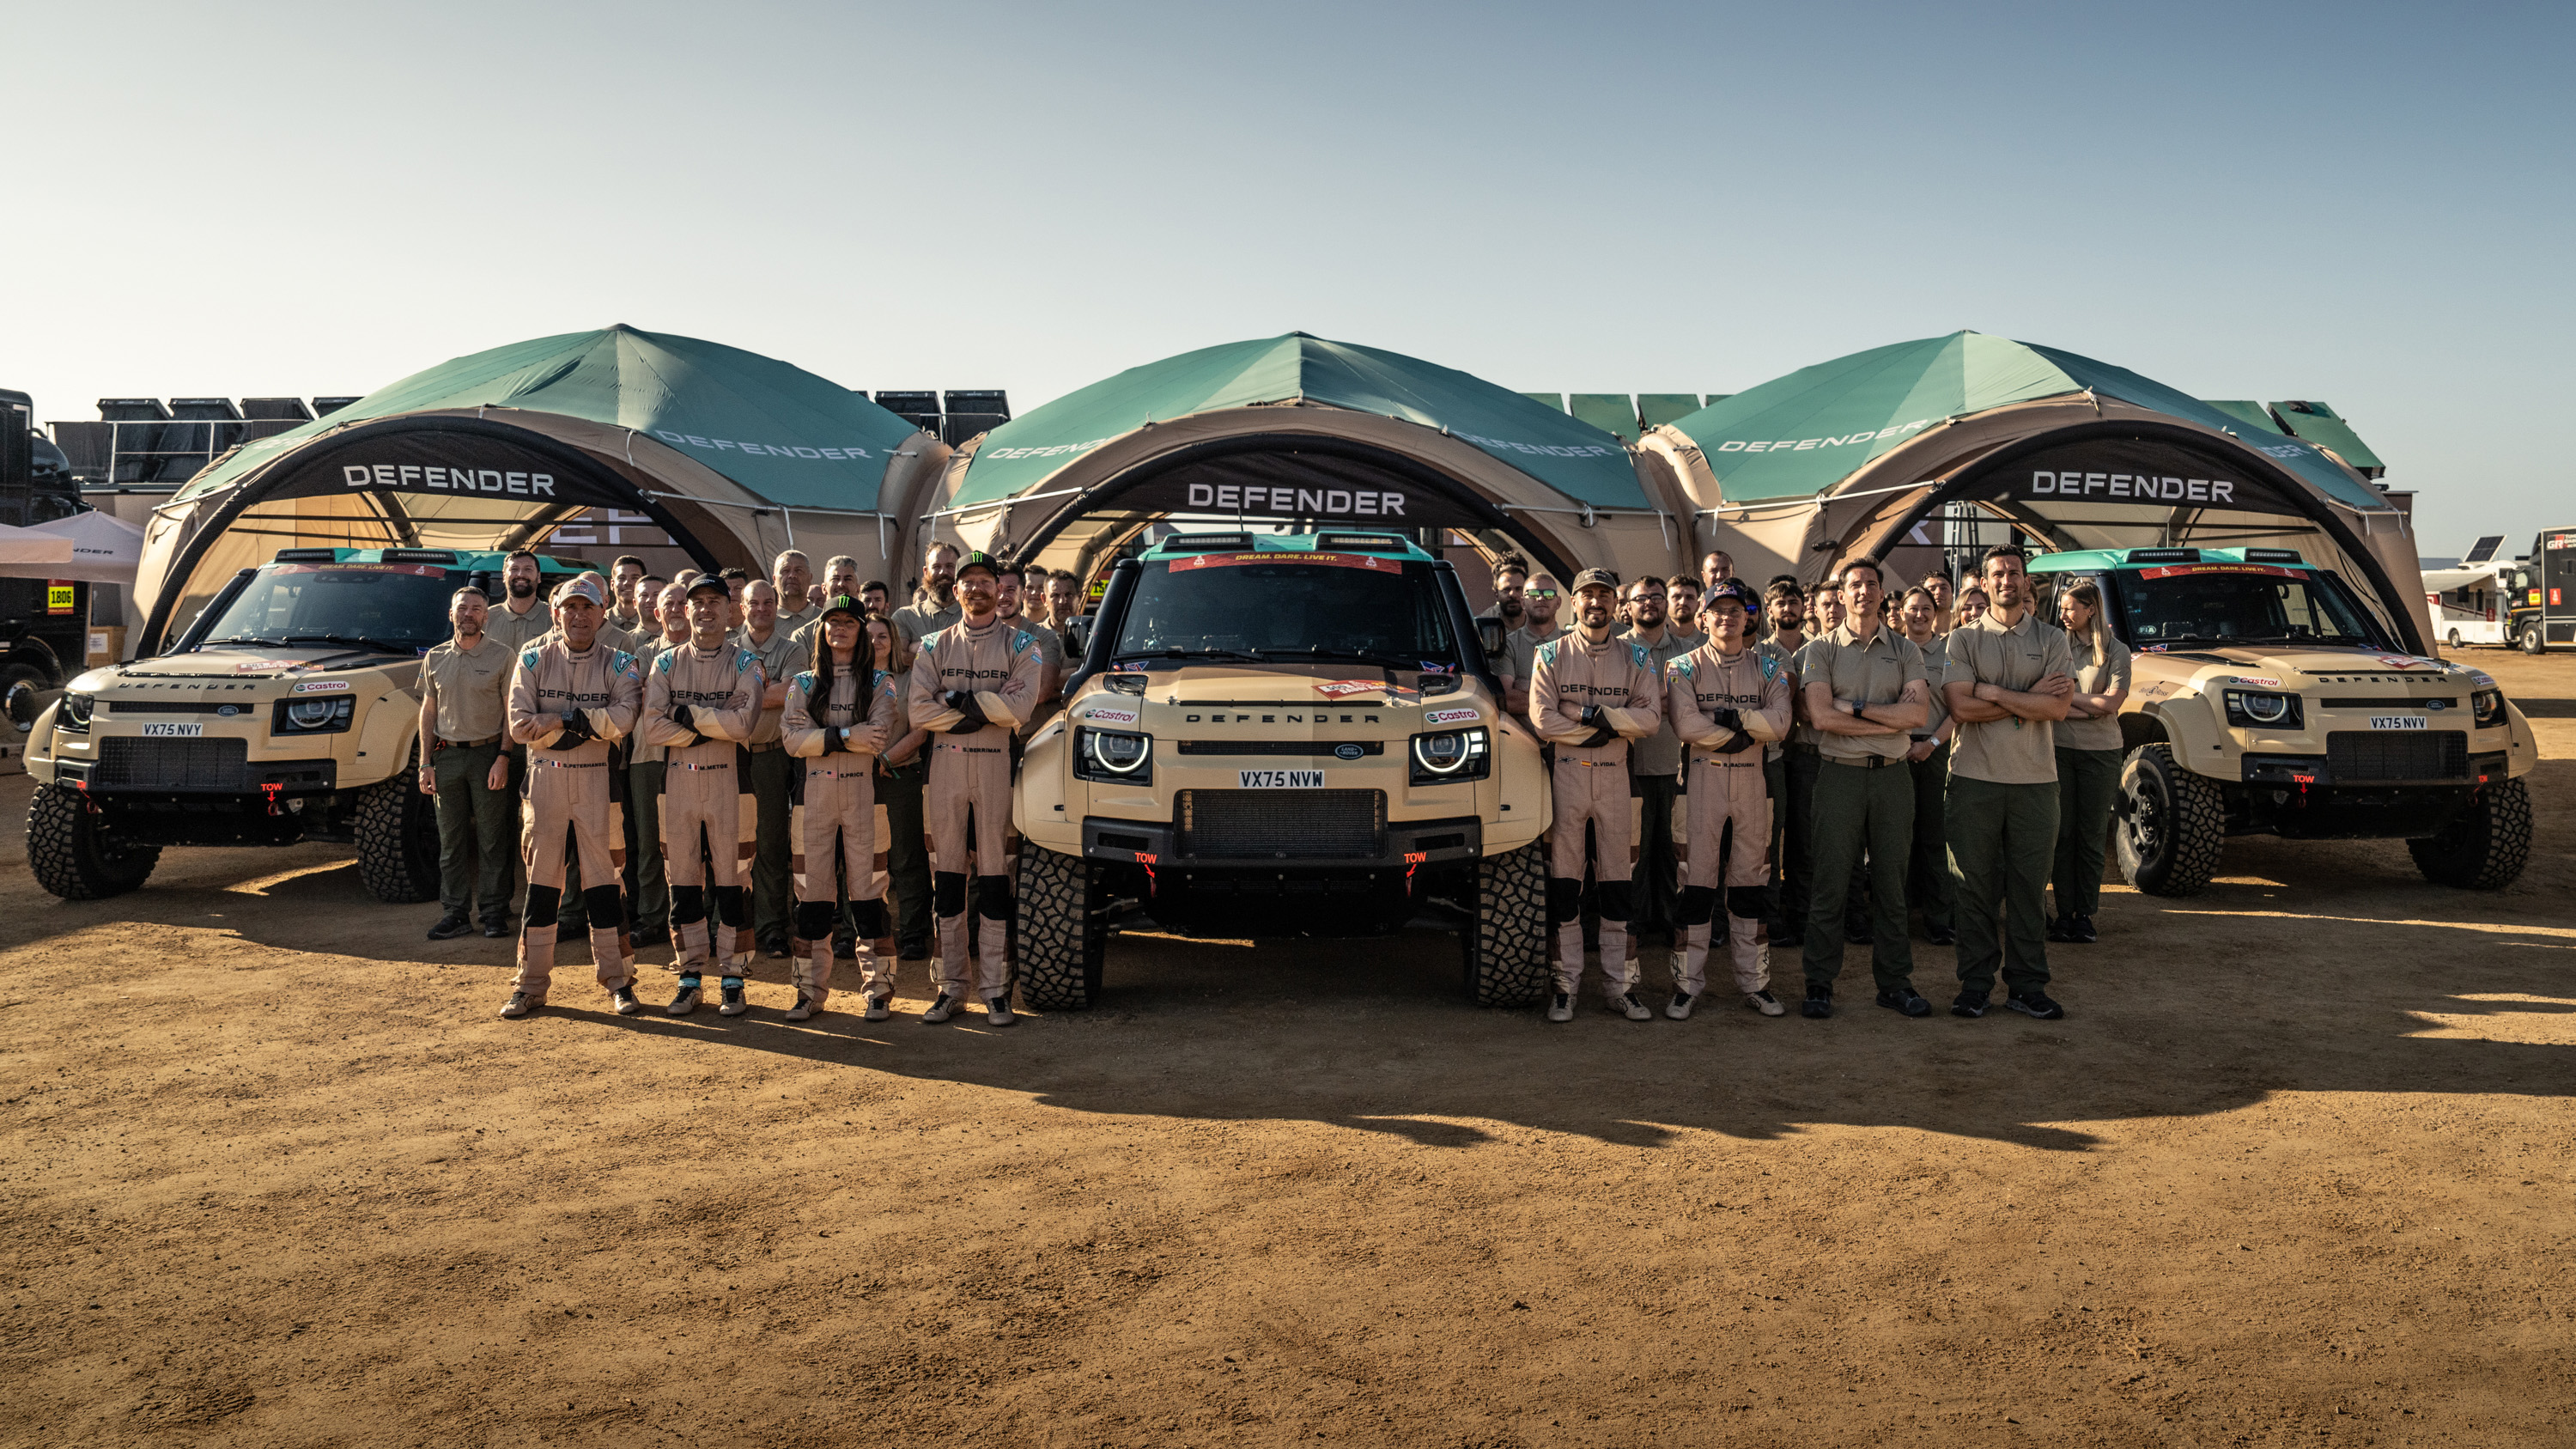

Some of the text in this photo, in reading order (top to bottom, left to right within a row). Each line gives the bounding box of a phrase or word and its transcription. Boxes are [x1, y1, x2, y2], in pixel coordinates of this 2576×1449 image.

[1717, 419, 1929, 453] DEFENDER
[655, 429, 873, 460] DEFENDER
[343, 465, 556, 496] DEFENDER
[2032, 471, 2233, 503] DEFENDER
[1188, 483, 1406, 515] DEFENDER
[2547, 539, 2563, 550] GR
[51, 590, 71, 604] 1806
[307, 682, 346, 691] Castrol
[2239, 677, 2278, 686] Castrol
[538, 689, 610, 702] DEFENDER
[1560, 684, 1630, 697] DEFENDER
[1095, 709, 1135, 721] Castrol
[1186, 715, 1380, 723] DEFENDER
[1437, 709, 1477, 721] Castrol
[2371, 717, 2426, 729] VX75 NVV
[144, 724, 202, 735] VX75 NVY
[1241, 771, 1324, 788] VX75 NVW
[2293, 775, 2315, 783] TOW
[260, 782, 283, 791] TOW
[1135, 852, 1157, 864] TOW
[1404, 852, 1427, 863] TOW
